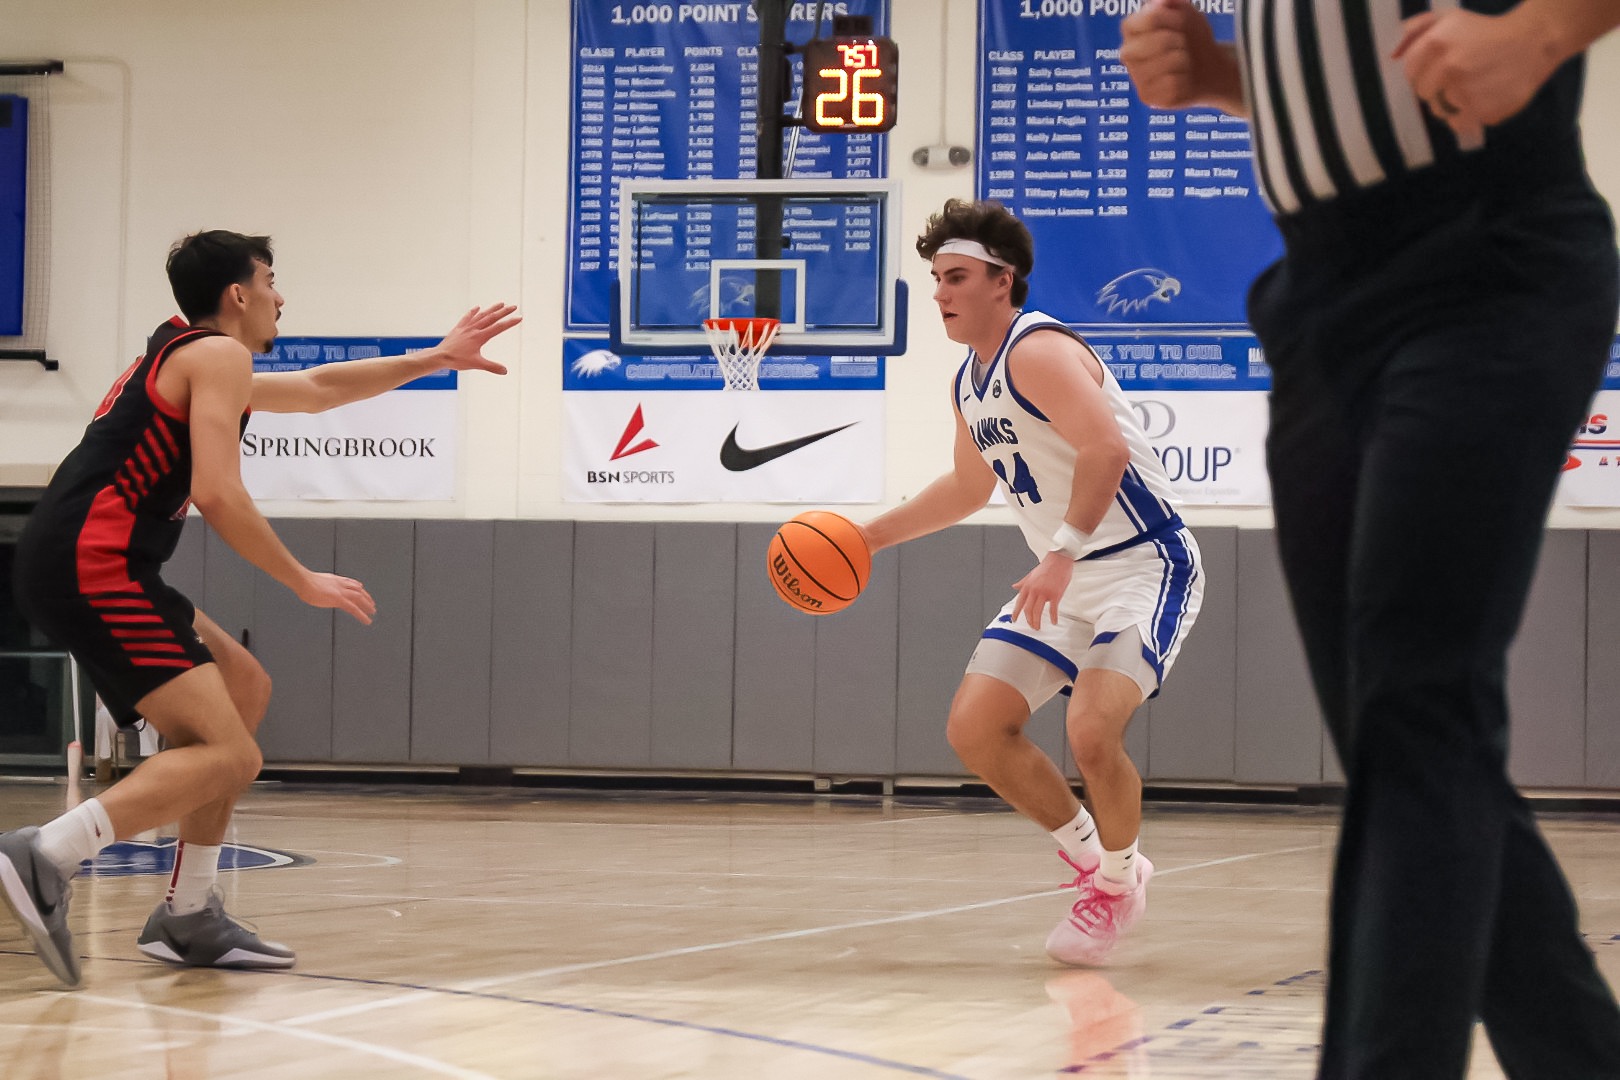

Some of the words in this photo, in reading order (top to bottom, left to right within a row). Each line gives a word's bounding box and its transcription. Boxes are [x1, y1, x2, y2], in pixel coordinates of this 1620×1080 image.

[611, 4, 673, 25] 1,000
[679, 4, 741, 23] POINT
[746, 2, 849, 22] SRERS
[1020, 0, 1084, 20] 1,000
[1090, 0, 1142, 16] POIN
[580, 47, 616, 57] CLASS
[625, 47, 665, 57] PLAYER
[684, 46, 724, 57] POINTS
[988, 51, 1024, 61] CLASS
[1034, 50, 1076, 60] PLAYER
[815, 69, 884, 126] 26
[284, 344, 320, 360] YOU
[324, 345, 345, 360] TO
[347, 344, 381, 360] OUR
[1116, 344, 1156, 360] YOU
[1159, 344, 1183, 360] TO
[1186, 344, 1222, 360] OUR
[1140, 363, 1237, 379] SPONSORS:
[241, 432, 437, 458] SPRINGBROOK
[587, 470, 621, 484] BSN
[623, 470, 676, 484] SPORTS
[773, 553, 823, 609] Wilson
